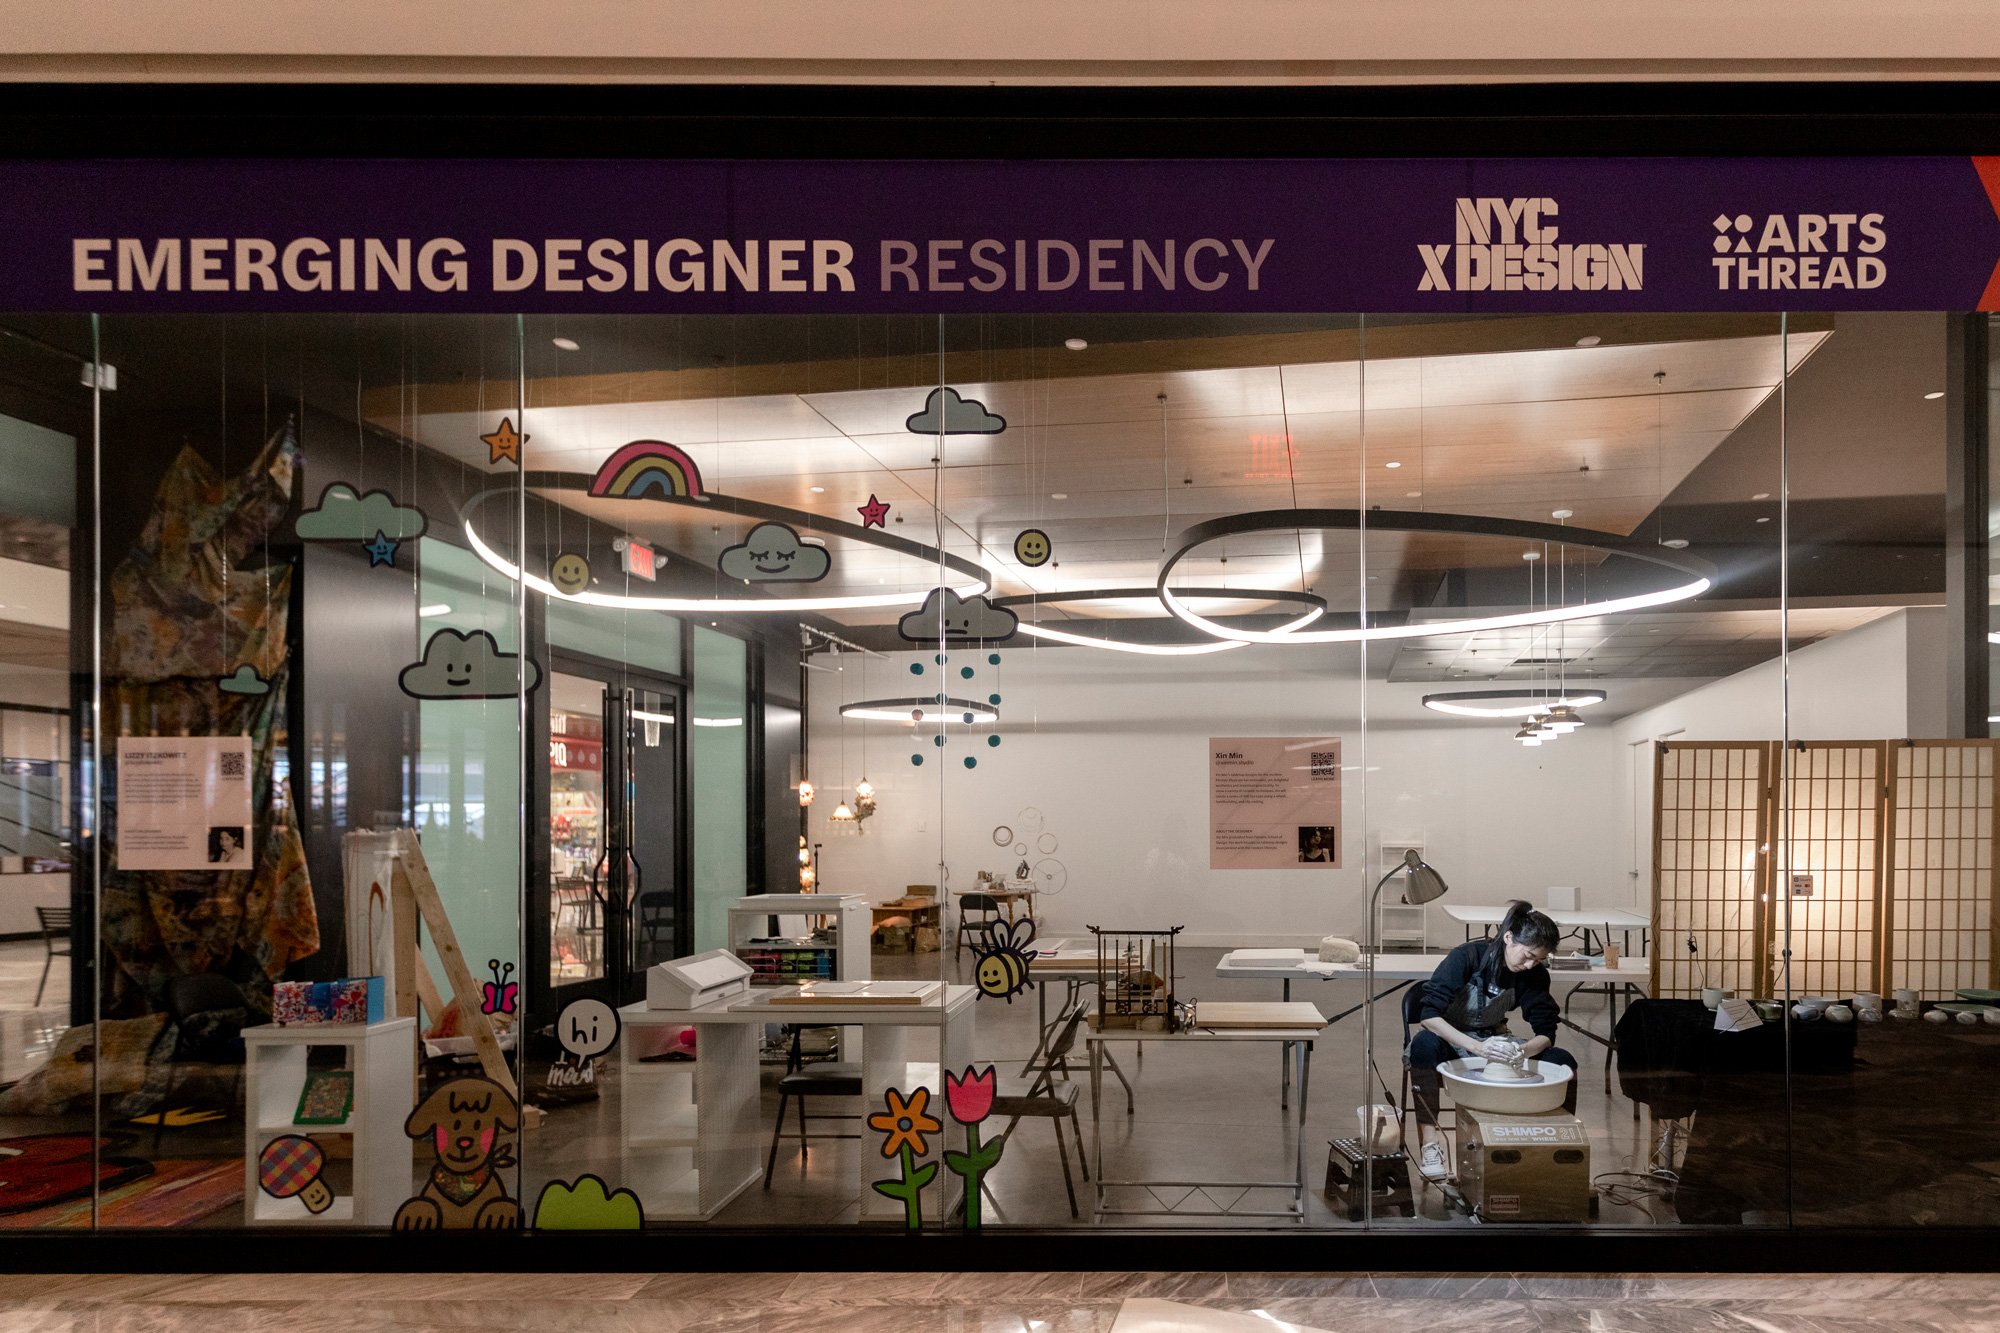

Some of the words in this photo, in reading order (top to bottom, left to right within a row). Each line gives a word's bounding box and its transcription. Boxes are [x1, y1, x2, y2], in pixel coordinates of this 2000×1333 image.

[1456, 198, 1558, 244] NYC
[1757, 213, 1887, 253] ARTS
[72, 237, 468, 292] EMERGING
[492, 238, 855, 292] DESIGNER
[880, 238, 1275, 292] RESIDENCY
[1712, 256, 1887, 290] THREAD
[572, 1016, 598, 1044] hi
[1492, 1126, 1556, 1136] SHIMPO
[1560, 1127, 1576, 1139] 21
